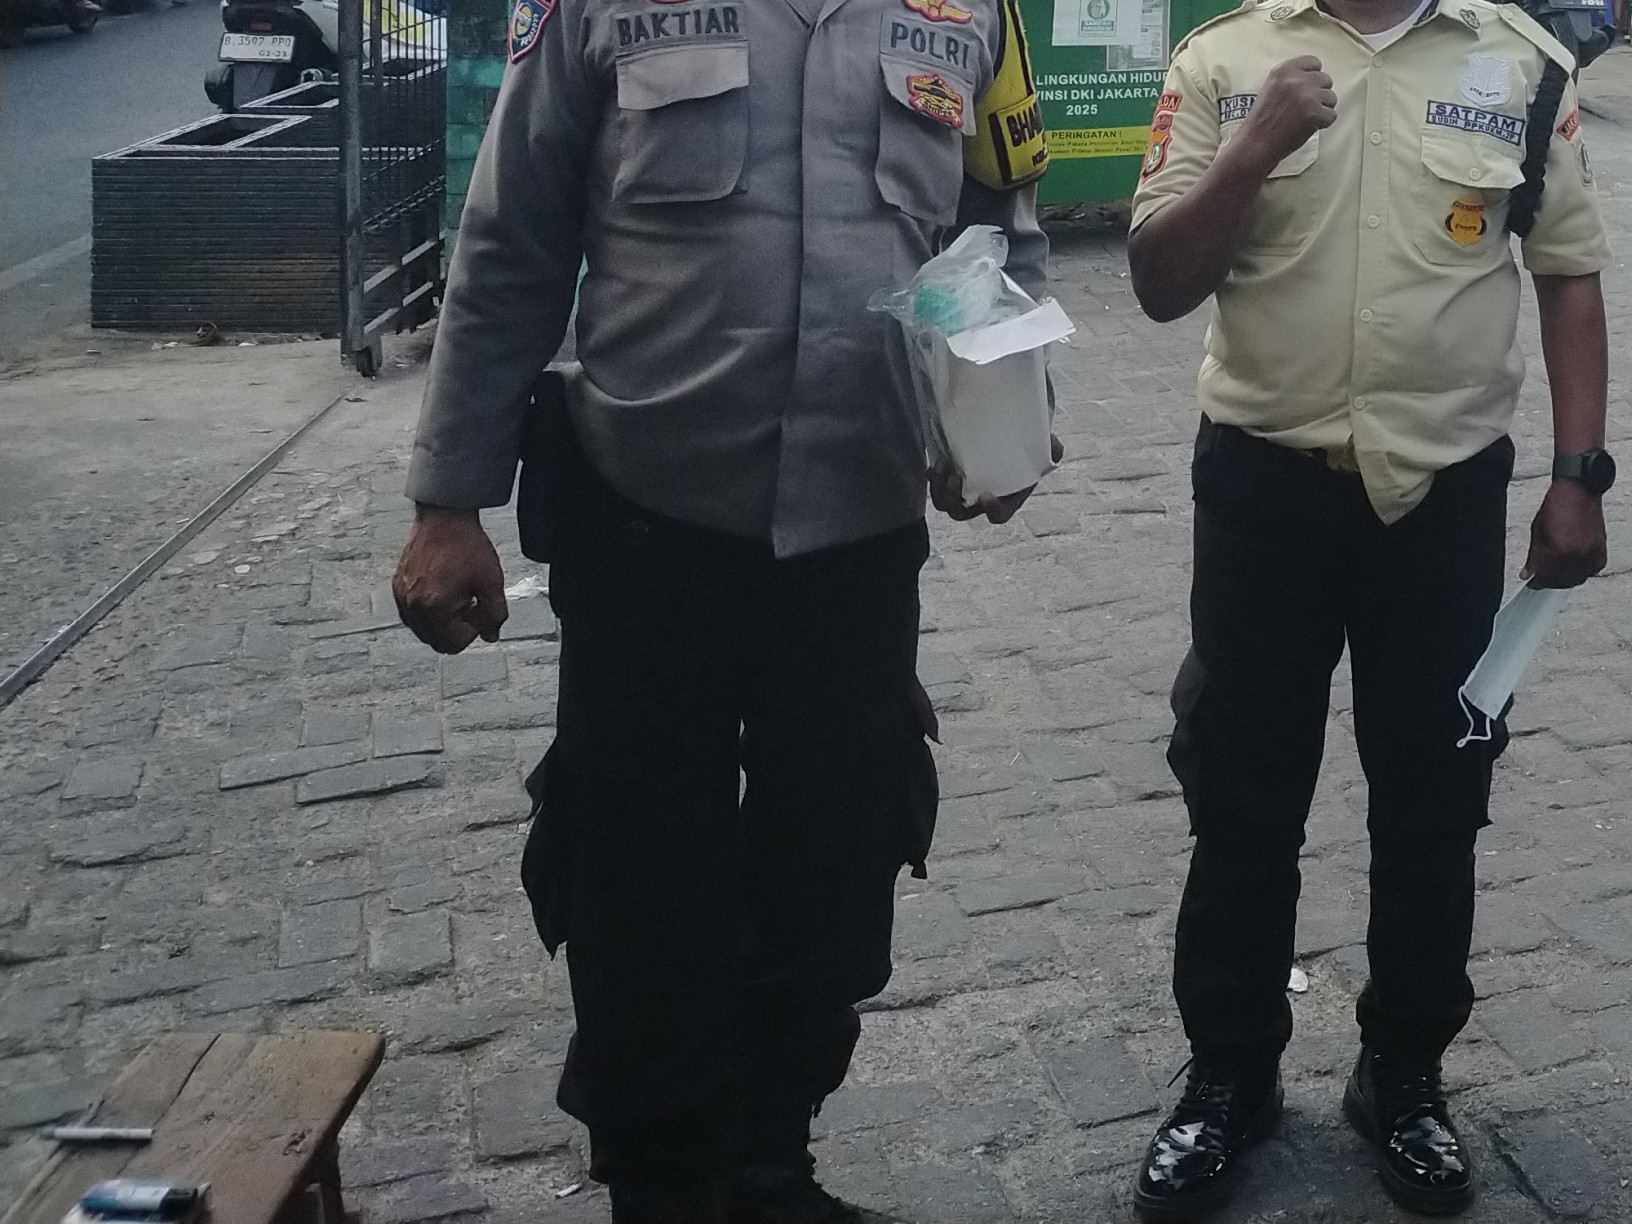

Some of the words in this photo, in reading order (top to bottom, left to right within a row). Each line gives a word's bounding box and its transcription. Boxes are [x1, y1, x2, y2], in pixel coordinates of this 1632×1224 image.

[616, 6, 739, 46] BAKTIAR
[224, 36, 231, 46] B
[890, 22, 970, 69] POLRI
[1036, 73, 1128, 86] LINGKUNGAN
[1071, 89, 1094, 101] DKI
[1097, 87, 1159, 100] JAKARTA
[1065, 104, 1099, 116] 2025
[1435, 104, 1517, 132] SATPAM
[1051, 131, 1117, 140] PERINGATAN
